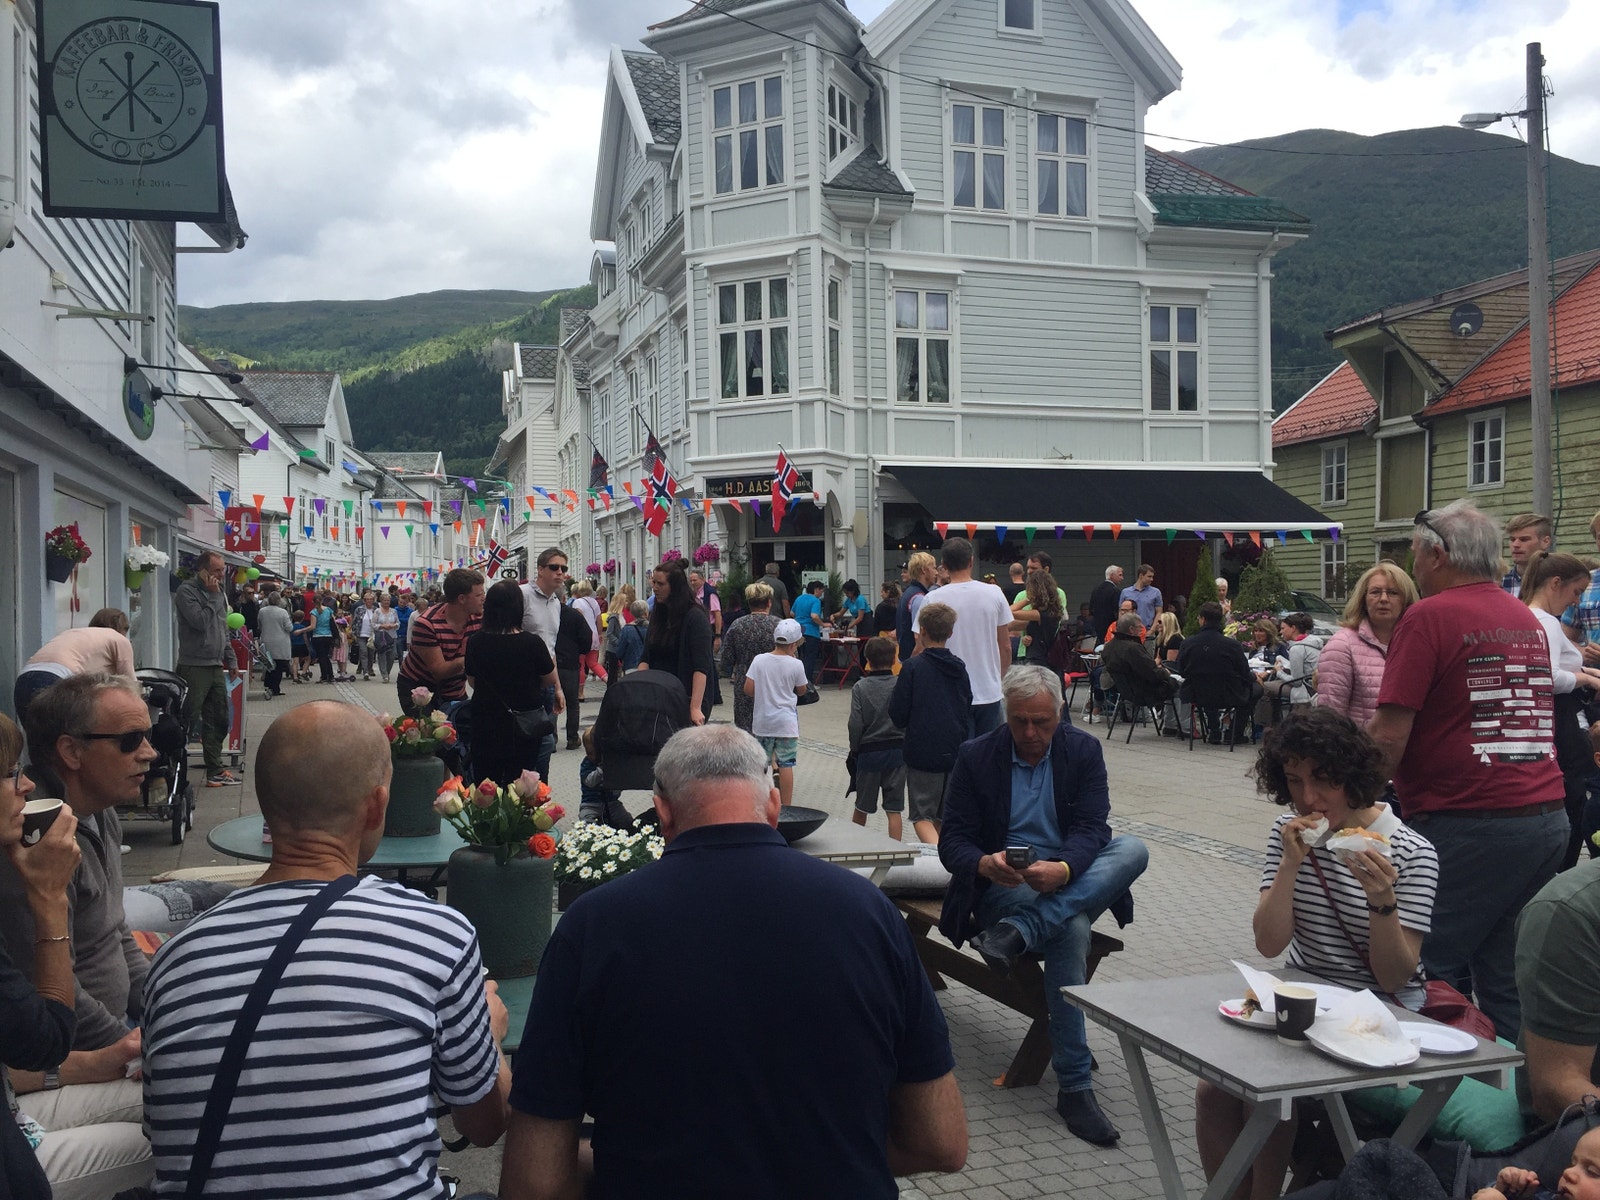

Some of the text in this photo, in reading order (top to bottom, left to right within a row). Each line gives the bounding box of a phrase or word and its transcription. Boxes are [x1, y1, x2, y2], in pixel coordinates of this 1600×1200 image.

[55, 23, 202, 88] KAFFEBAR & FRISØR
[89, 130, 177, 159] COCO
